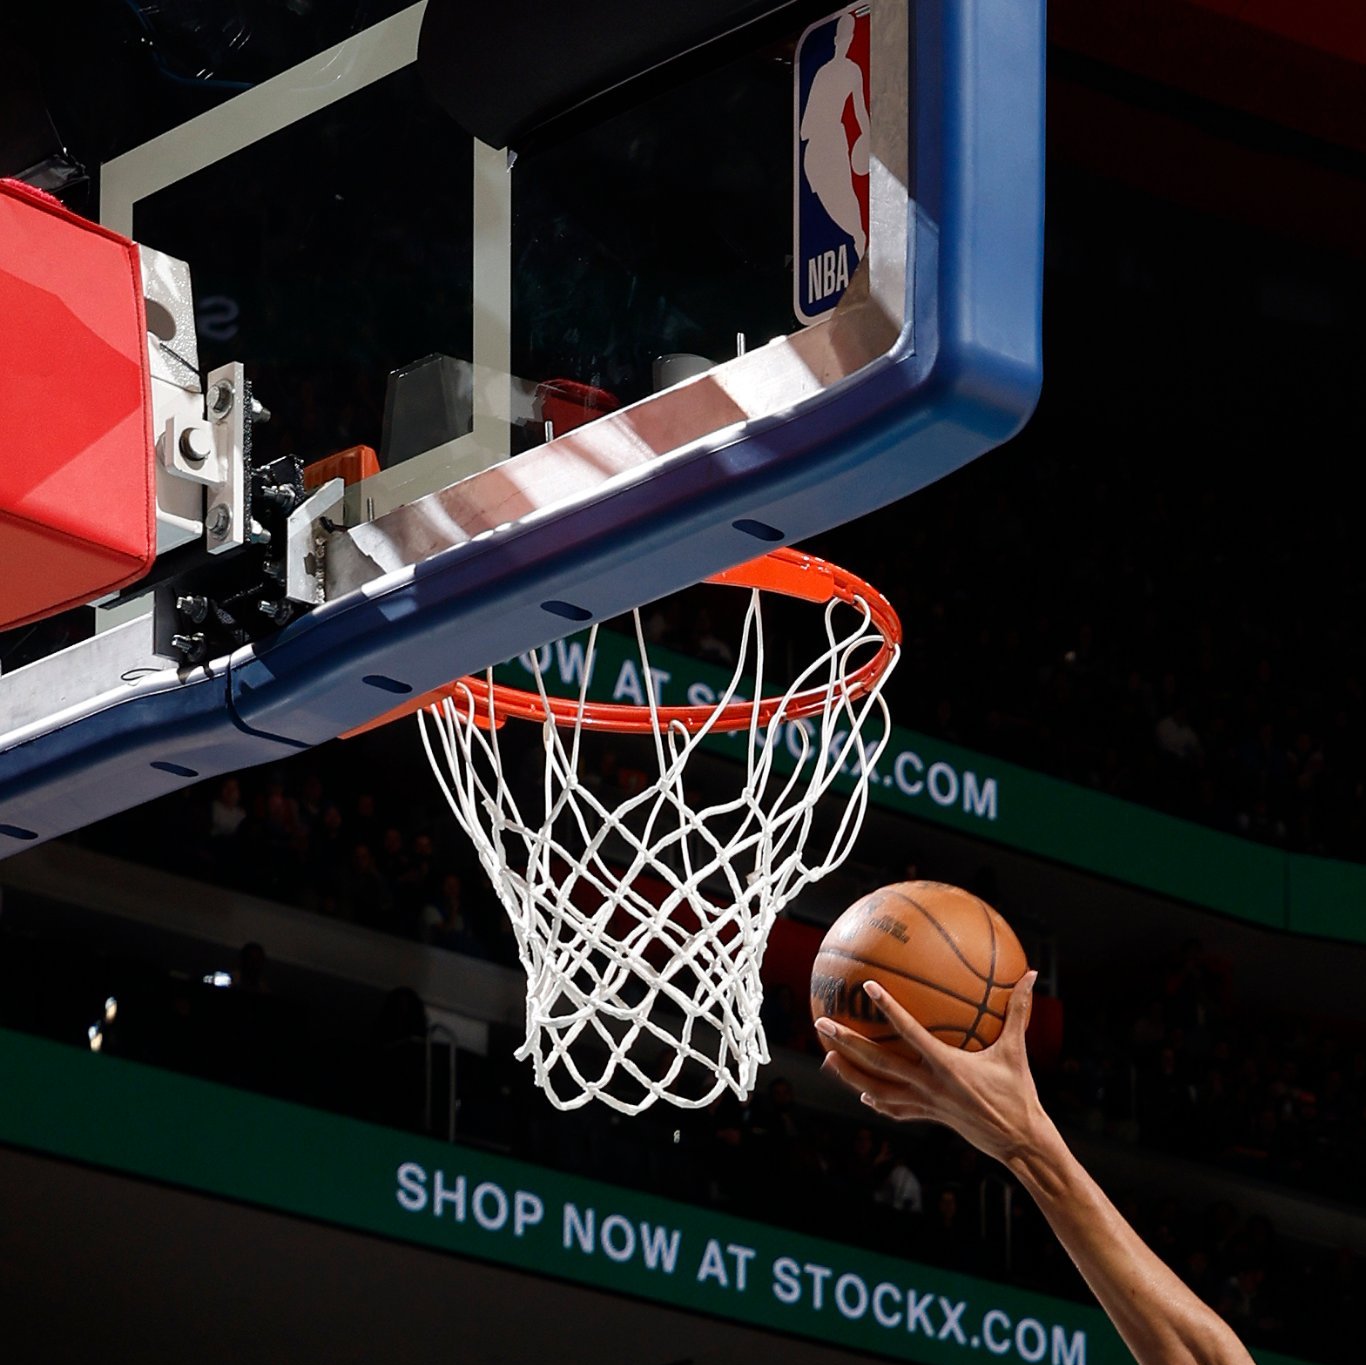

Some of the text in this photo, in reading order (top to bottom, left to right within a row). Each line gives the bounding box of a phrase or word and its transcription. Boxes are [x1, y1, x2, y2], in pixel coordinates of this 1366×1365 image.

[808, 243, 849, 304] NBA
[613, 659, 672, 707] AT
[687, 682, 998, 820] SOCKX.COM
[396, 1162, 544, 1236] SHOP
[562, 1202, 681, 1273] NOW
[697, 1239, 756, 1291] AT
